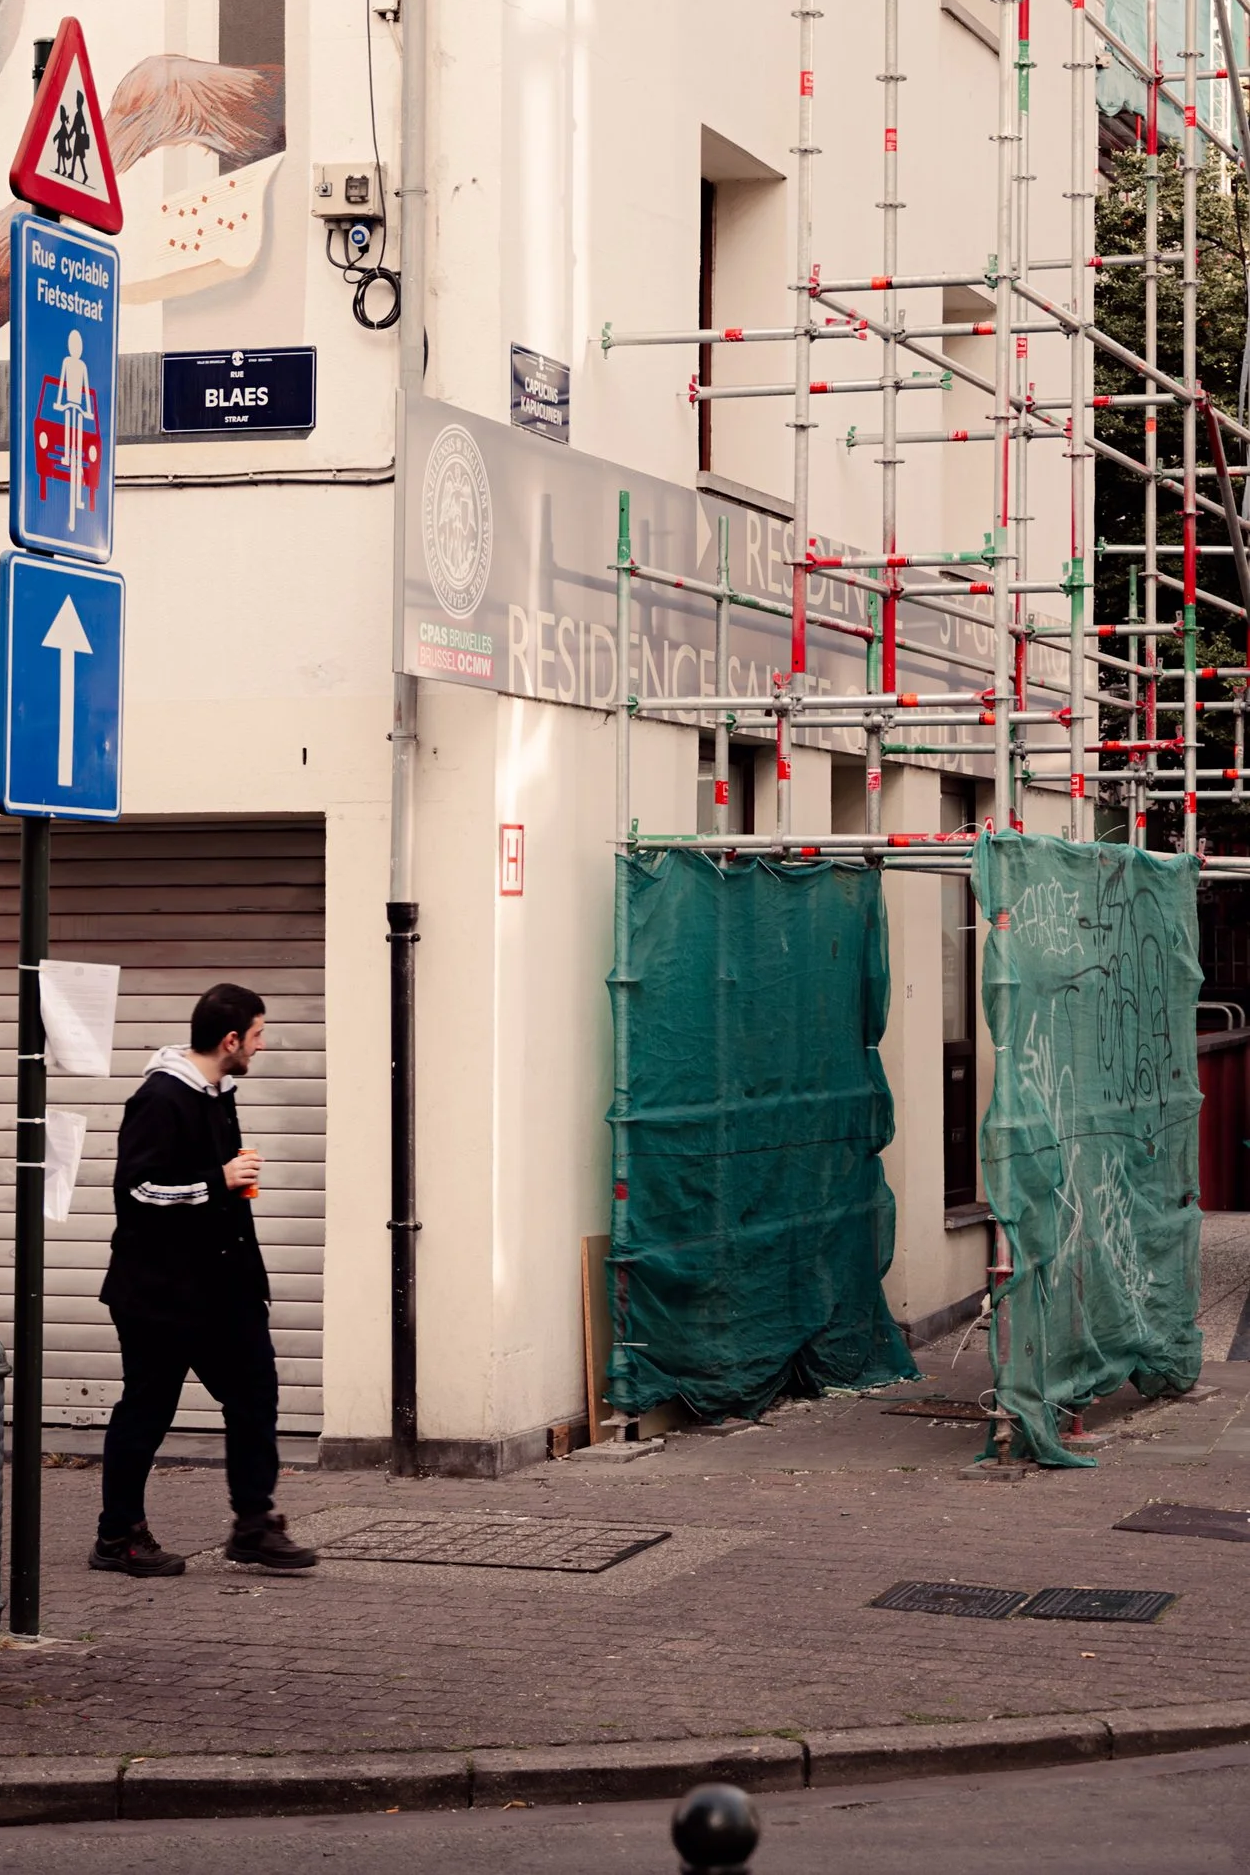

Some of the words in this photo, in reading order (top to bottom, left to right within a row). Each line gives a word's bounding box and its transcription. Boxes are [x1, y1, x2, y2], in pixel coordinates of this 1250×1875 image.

[32, 240, 56, 270] Rue
[61, 257, 109, 289] cyclable
[37, 278, 103, 321] Fietsstraat
[206, 387, 268, 407] BLAES
[525, 377, 558, 403] CAPUCINS
[225, 415, 249, 423] STRAAT
[420, 623, 447, 646] CPAS
[450, 629, 492, 655] BRUXELLES
[420, 646, 457, 670] BRUSSEL
[458, 653, 491, 676] OCMW
